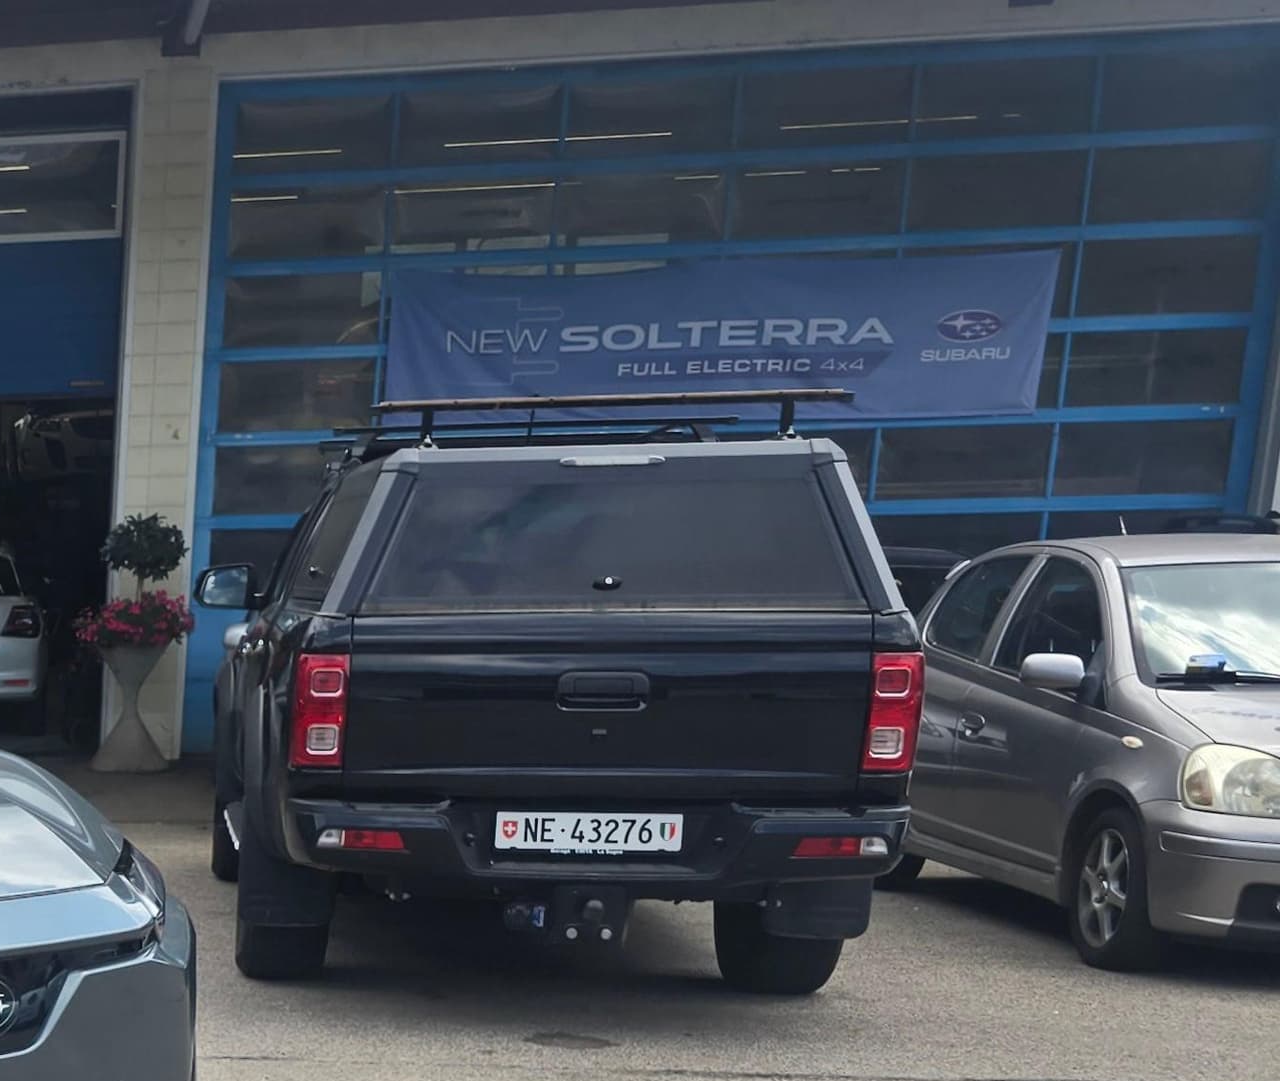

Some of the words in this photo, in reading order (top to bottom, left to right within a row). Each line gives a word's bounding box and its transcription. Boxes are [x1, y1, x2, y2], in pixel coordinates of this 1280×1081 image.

[446, 328, 548, 353] NEW
[559, 317, 894, 352] SOLTERRA
[920, 346, 1011, 362] SUBARU
[617, 361, 677, 376] FULL
[686, 358, 812, 374] ELECTRIC
[820, 357, 865, 371] 4x4
